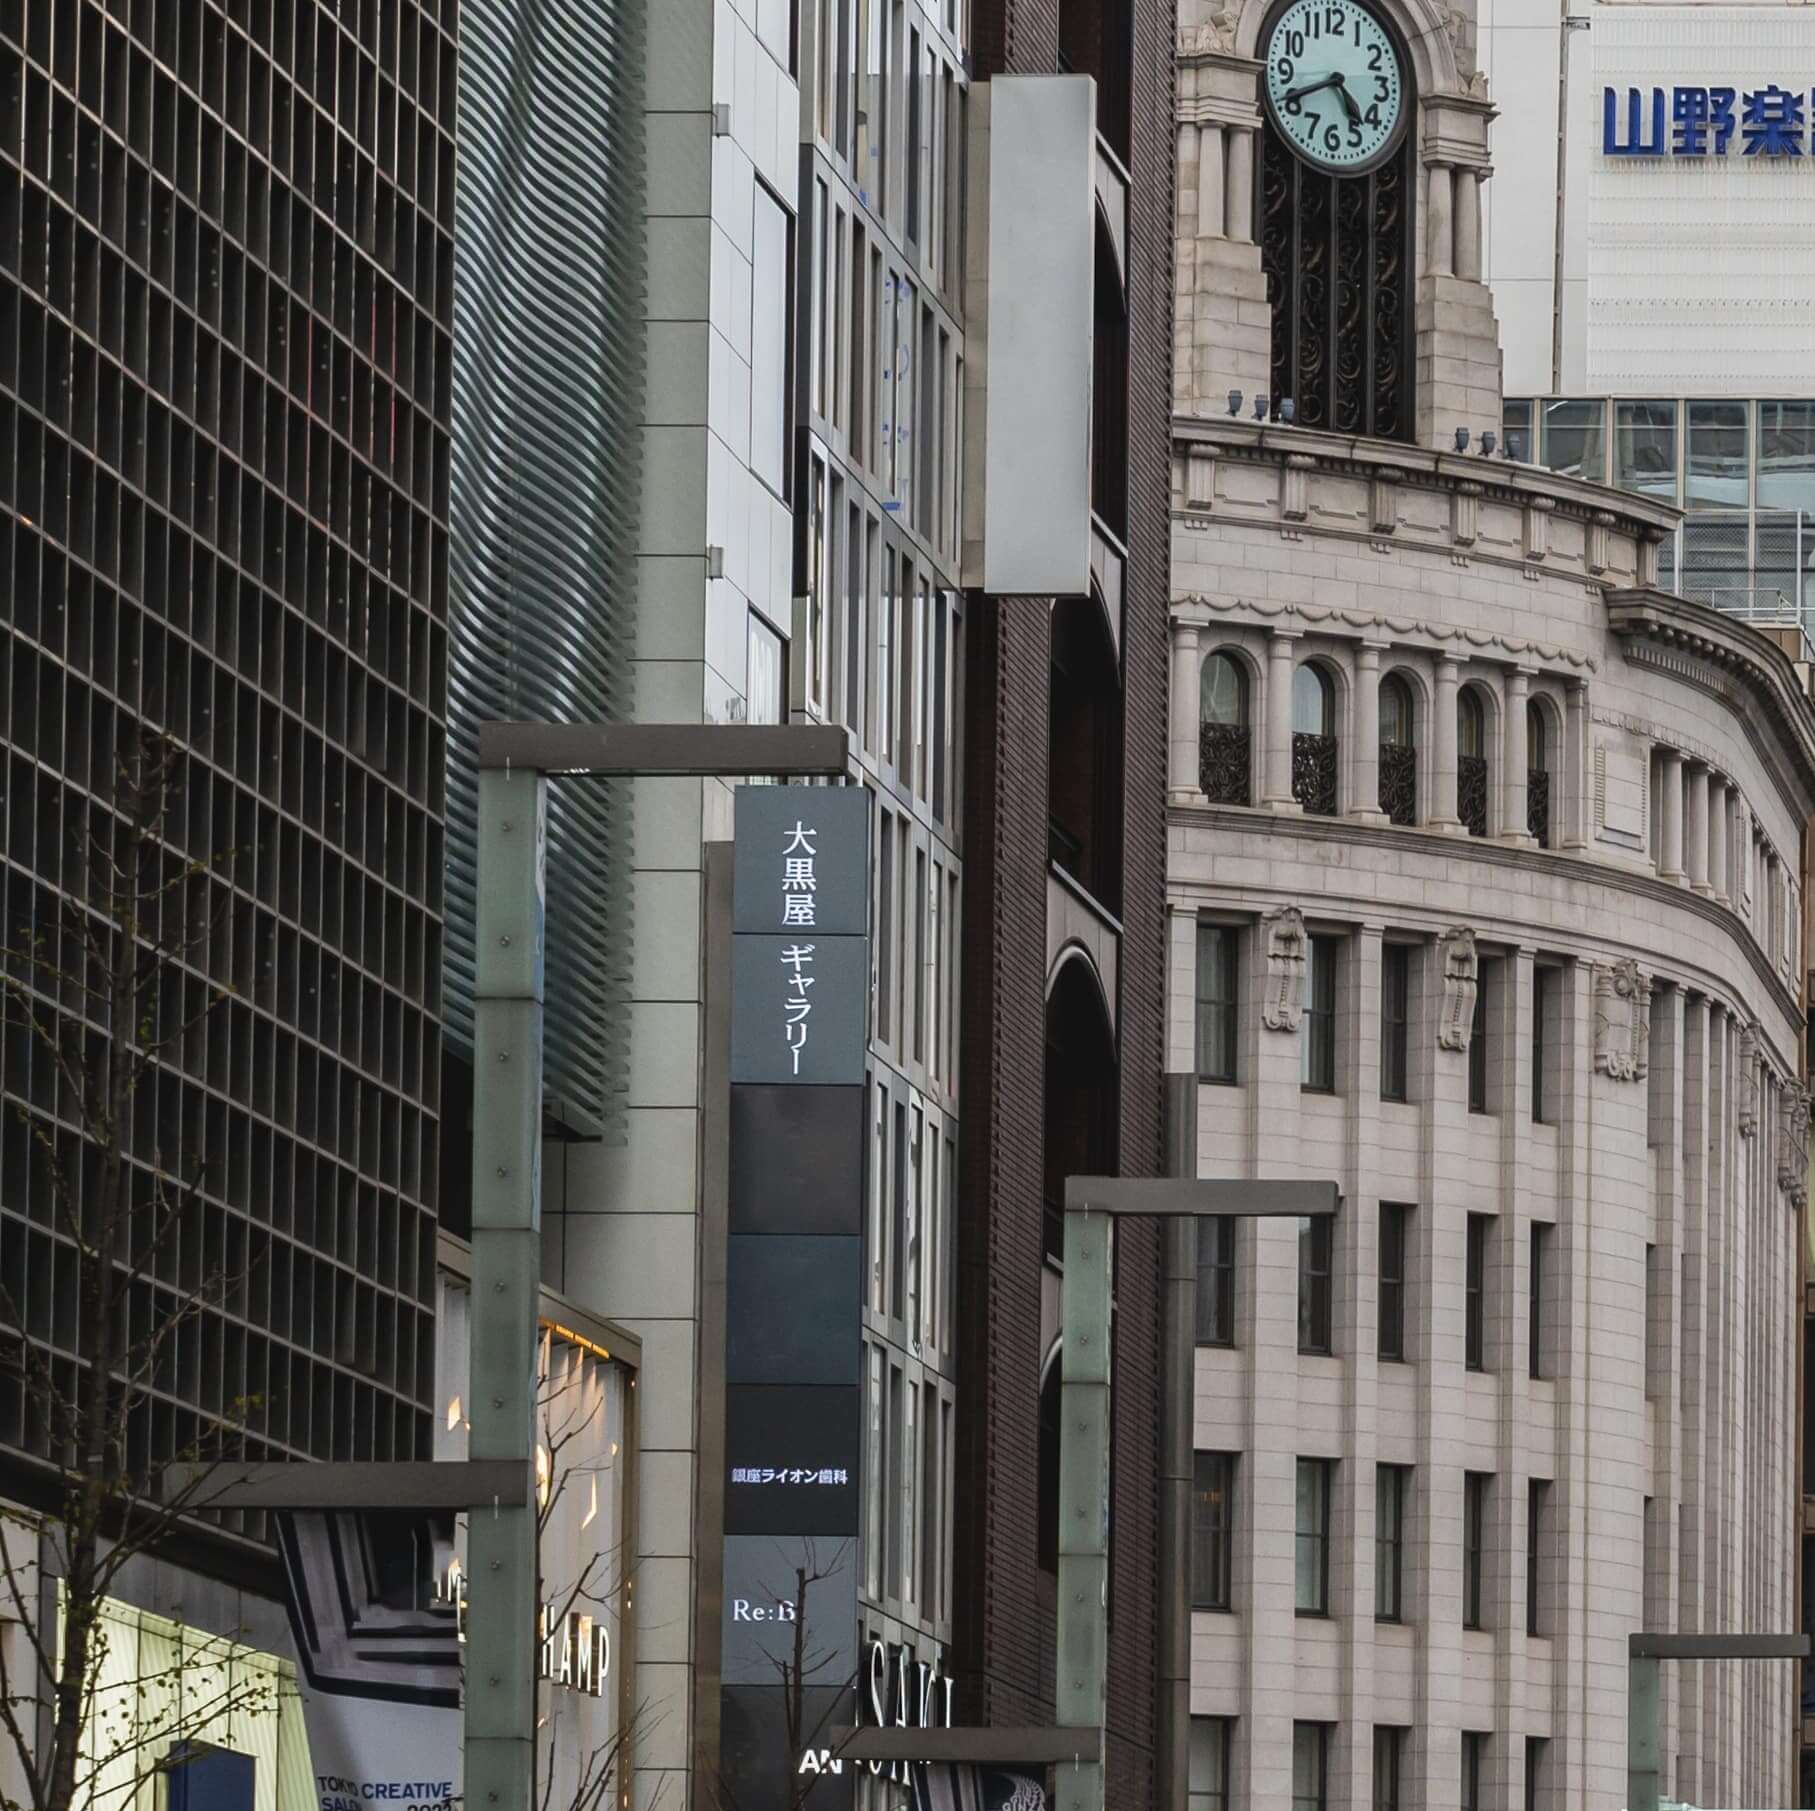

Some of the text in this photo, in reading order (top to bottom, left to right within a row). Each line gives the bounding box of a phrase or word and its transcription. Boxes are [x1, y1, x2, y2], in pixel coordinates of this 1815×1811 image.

[1305, 11, 1319, 39] 11
[1325, 8, 1345, 36] 12
[1355, 20, 1360, 47] 1
[1286, 30, 1304, 58] 10
[1367, 44, 1382, 71] 2
[1278, 58, 1293, 84] 9
[1374, 76, 1389, 102] 3
[1304, 112, 1320, 139] 7
[1365, 104, 1382, 131] 4
[1325, 124, 1340, 151] 6
[780, 820, 816, 1076] 大黒屋 ギャラリー
[732, 1468, 848, 1485] 銀座ライオン歯科
[361, 1782, 452, 1799] CREATIVE
